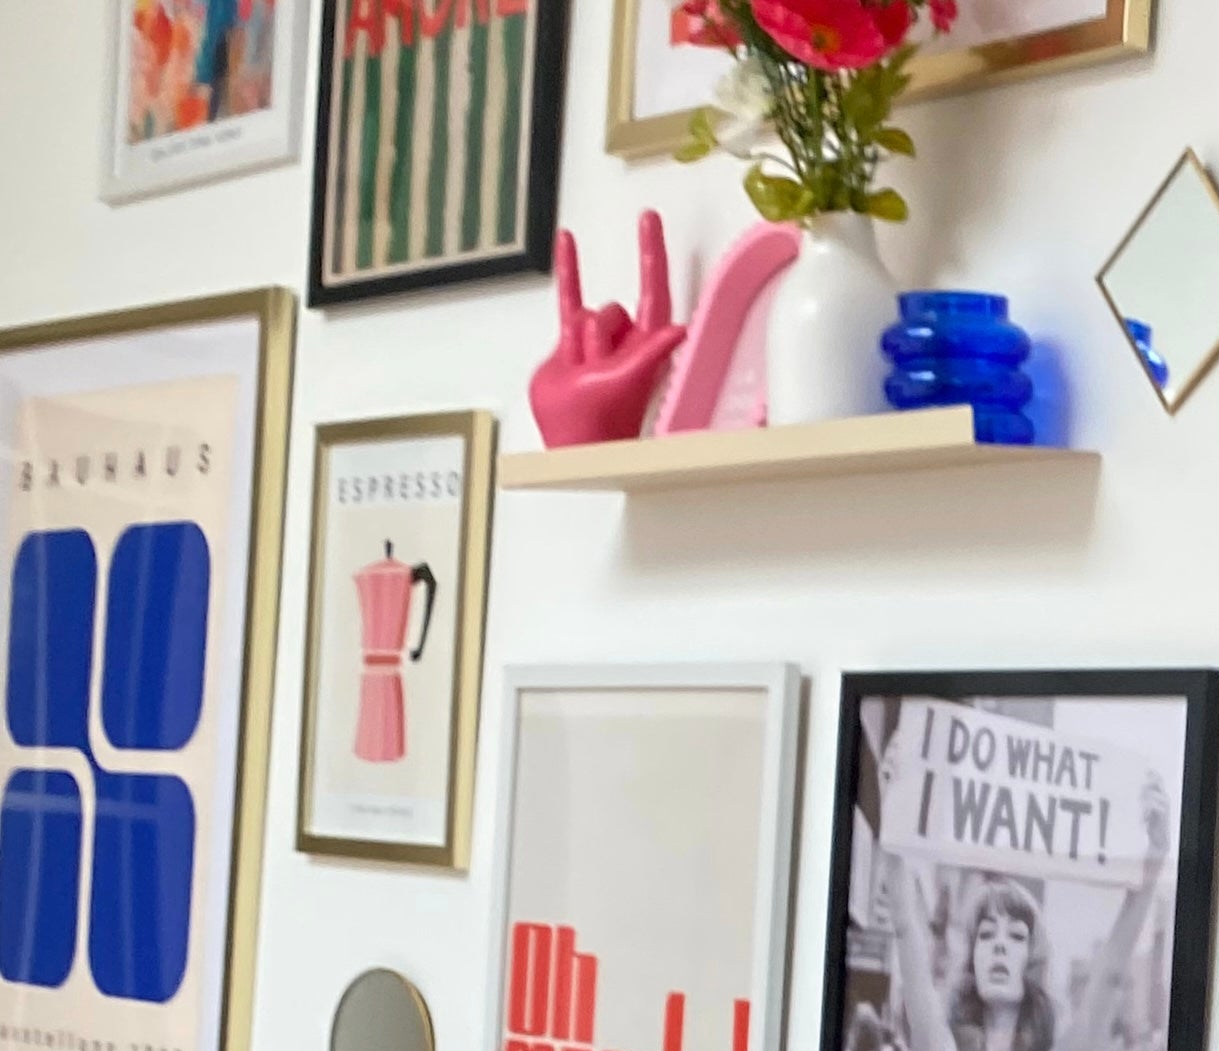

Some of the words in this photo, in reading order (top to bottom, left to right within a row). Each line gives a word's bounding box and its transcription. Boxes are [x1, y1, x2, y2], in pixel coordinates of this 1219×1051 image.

[20, 443, 210, 492] BAUHAUS
[338, 471, 459, 504] ESPRESSO
[921, 707, 935, 760] I
[947, 716, 996, 772] DO
[1006, 734, 1100, 790] WHAT
[917, 770, 935, 837] I
[952, 775, 1111, 866] WANT!
